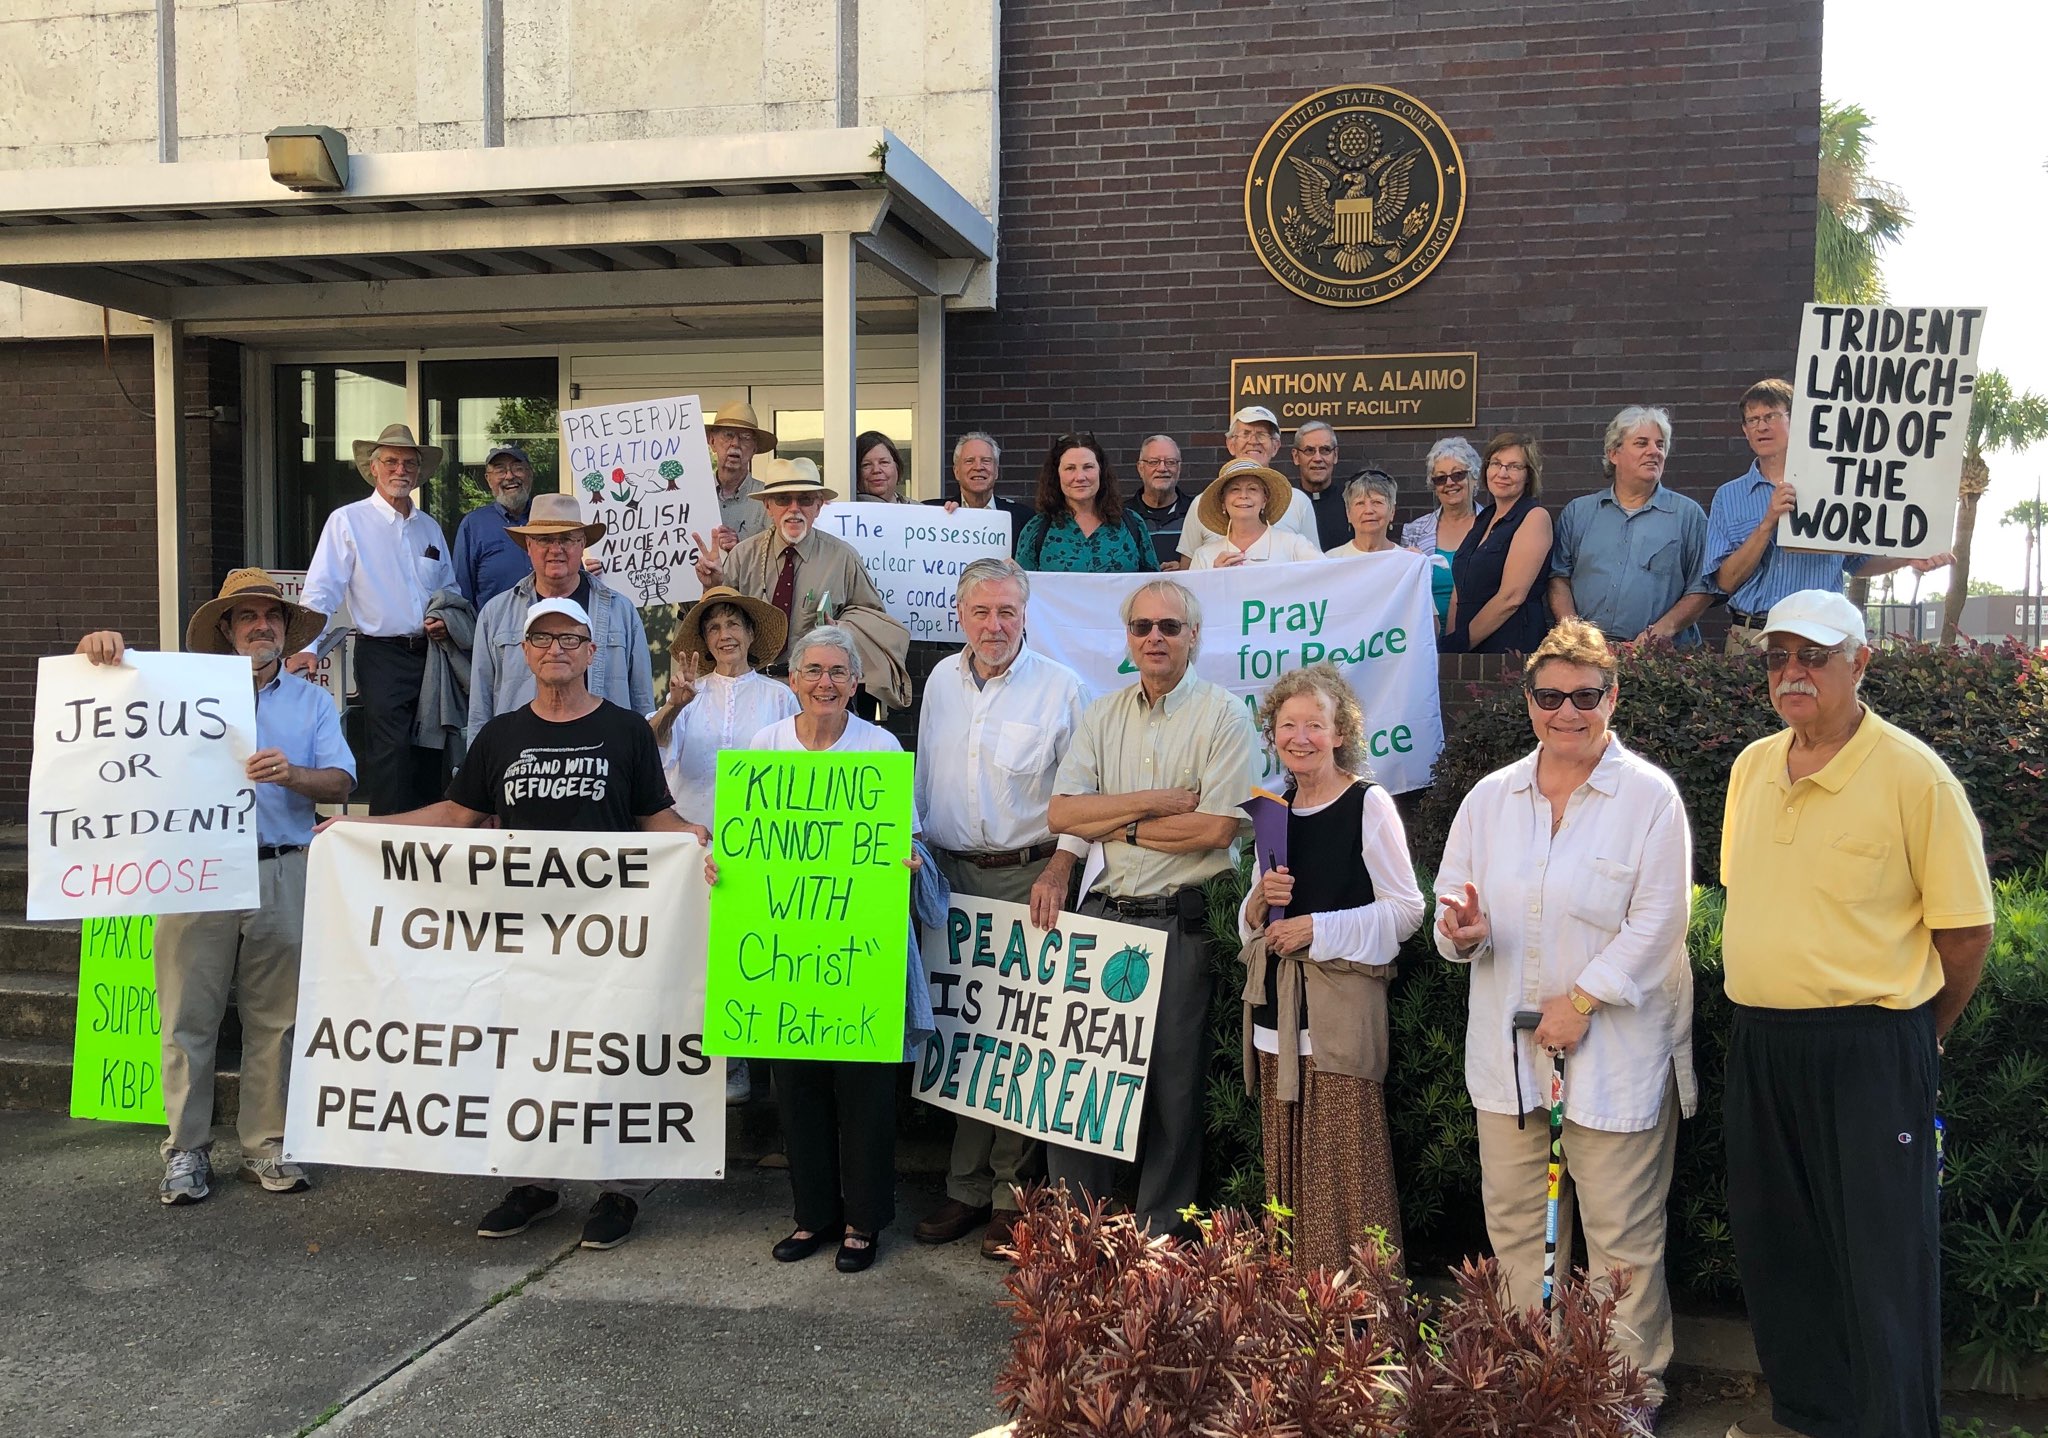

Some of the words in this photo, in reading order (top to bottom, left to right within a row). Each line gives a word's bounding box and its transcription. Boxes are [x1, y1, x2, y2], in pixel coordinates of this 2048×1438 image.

[1276, 100, 1327, 140] UNITED
[1335, 92, 1385, 106] STATES
[1392, 100, 1435, 133] COURT
[1257, 227, 1311, 288] SOUTHERN
[1315, 283, 1380, 299] DISTRICT
[1388, 272, 1406, 289] OF
[1412, 215, 1454, 273] GEORGIA
[1812, 307, 1982, 356] TRIDENT
[1240, 372, 1347, 396] ANTHONY
[1352, 371, 1373, 392] A.
[1379, 368, 1466, 392] ALAIMO
[564, 403, 692, 442] PRESERVE
[1282, 401, 1343, 417] COURT
[1346, 399, 1422, 416] FACILITY
[1809, 404, 1890, 454] END
[1897, 410, 1952, 459] OF
[570, 436, 681, 472] CREATION
[1826, 456, 1908, 501] THE
[592, 503, 690, 535] ABOLISH
[602, 527, 690, 557] NUCLEAR
[834, 514, 884, 538] The
[905, 526, 1006, 549] possession
[1788, 498, 1928, 548] WORLD
[861, 550, 915, 573] uclear
[1241, 598, 1329, 637] Pray
[1237, 644, 1291, 680] for
[1301, 627, 1408, 669] Peace
[55, 697, 227, 743] JESUS
[98, 753, 163, 783] OR
[520, 759, 561, 775] STAND
[564, 757, 609, 777] WITH
[504, 777, 607, 806] REFUGEES
[39, 788, 257, 847] TRIDENT?
[721, 816, 844, 862] CANNOT
[852, 821, 896, 866] BE
[60, 858, 223, 898] CHOOSE
[380, 839, 454, 884] MY
[468, 844, 651, 889] PEACE
[766, 875, 854, 921] WITH
[89, 916, 132, 960] PAX
[369, 905, 385, 948] I
[401, 907, 525, 955] GIVE
[541, 913, 650, 959] YOU
[947, 906, 1098, 994] PEACE
[723, 999, 762, 1045] St.
[777, 1001, 880, 1047] Patrick
[929, 971, 984, 1025] IS
[996, 984, 1053, 1042] THE
[1058, 1000, 1148, 1067] REAL
[304, 1016, 519, 1070] ACCEPT
[532, 1029, 712, 1076] JESUS
[101, 1057, 155, 1110] KBP
[919, 1026, 1145, 1152] DETERRENT
[316, 1085, 490, 1139] PEACE
[506, 1097, 696, 1145] OFFER
